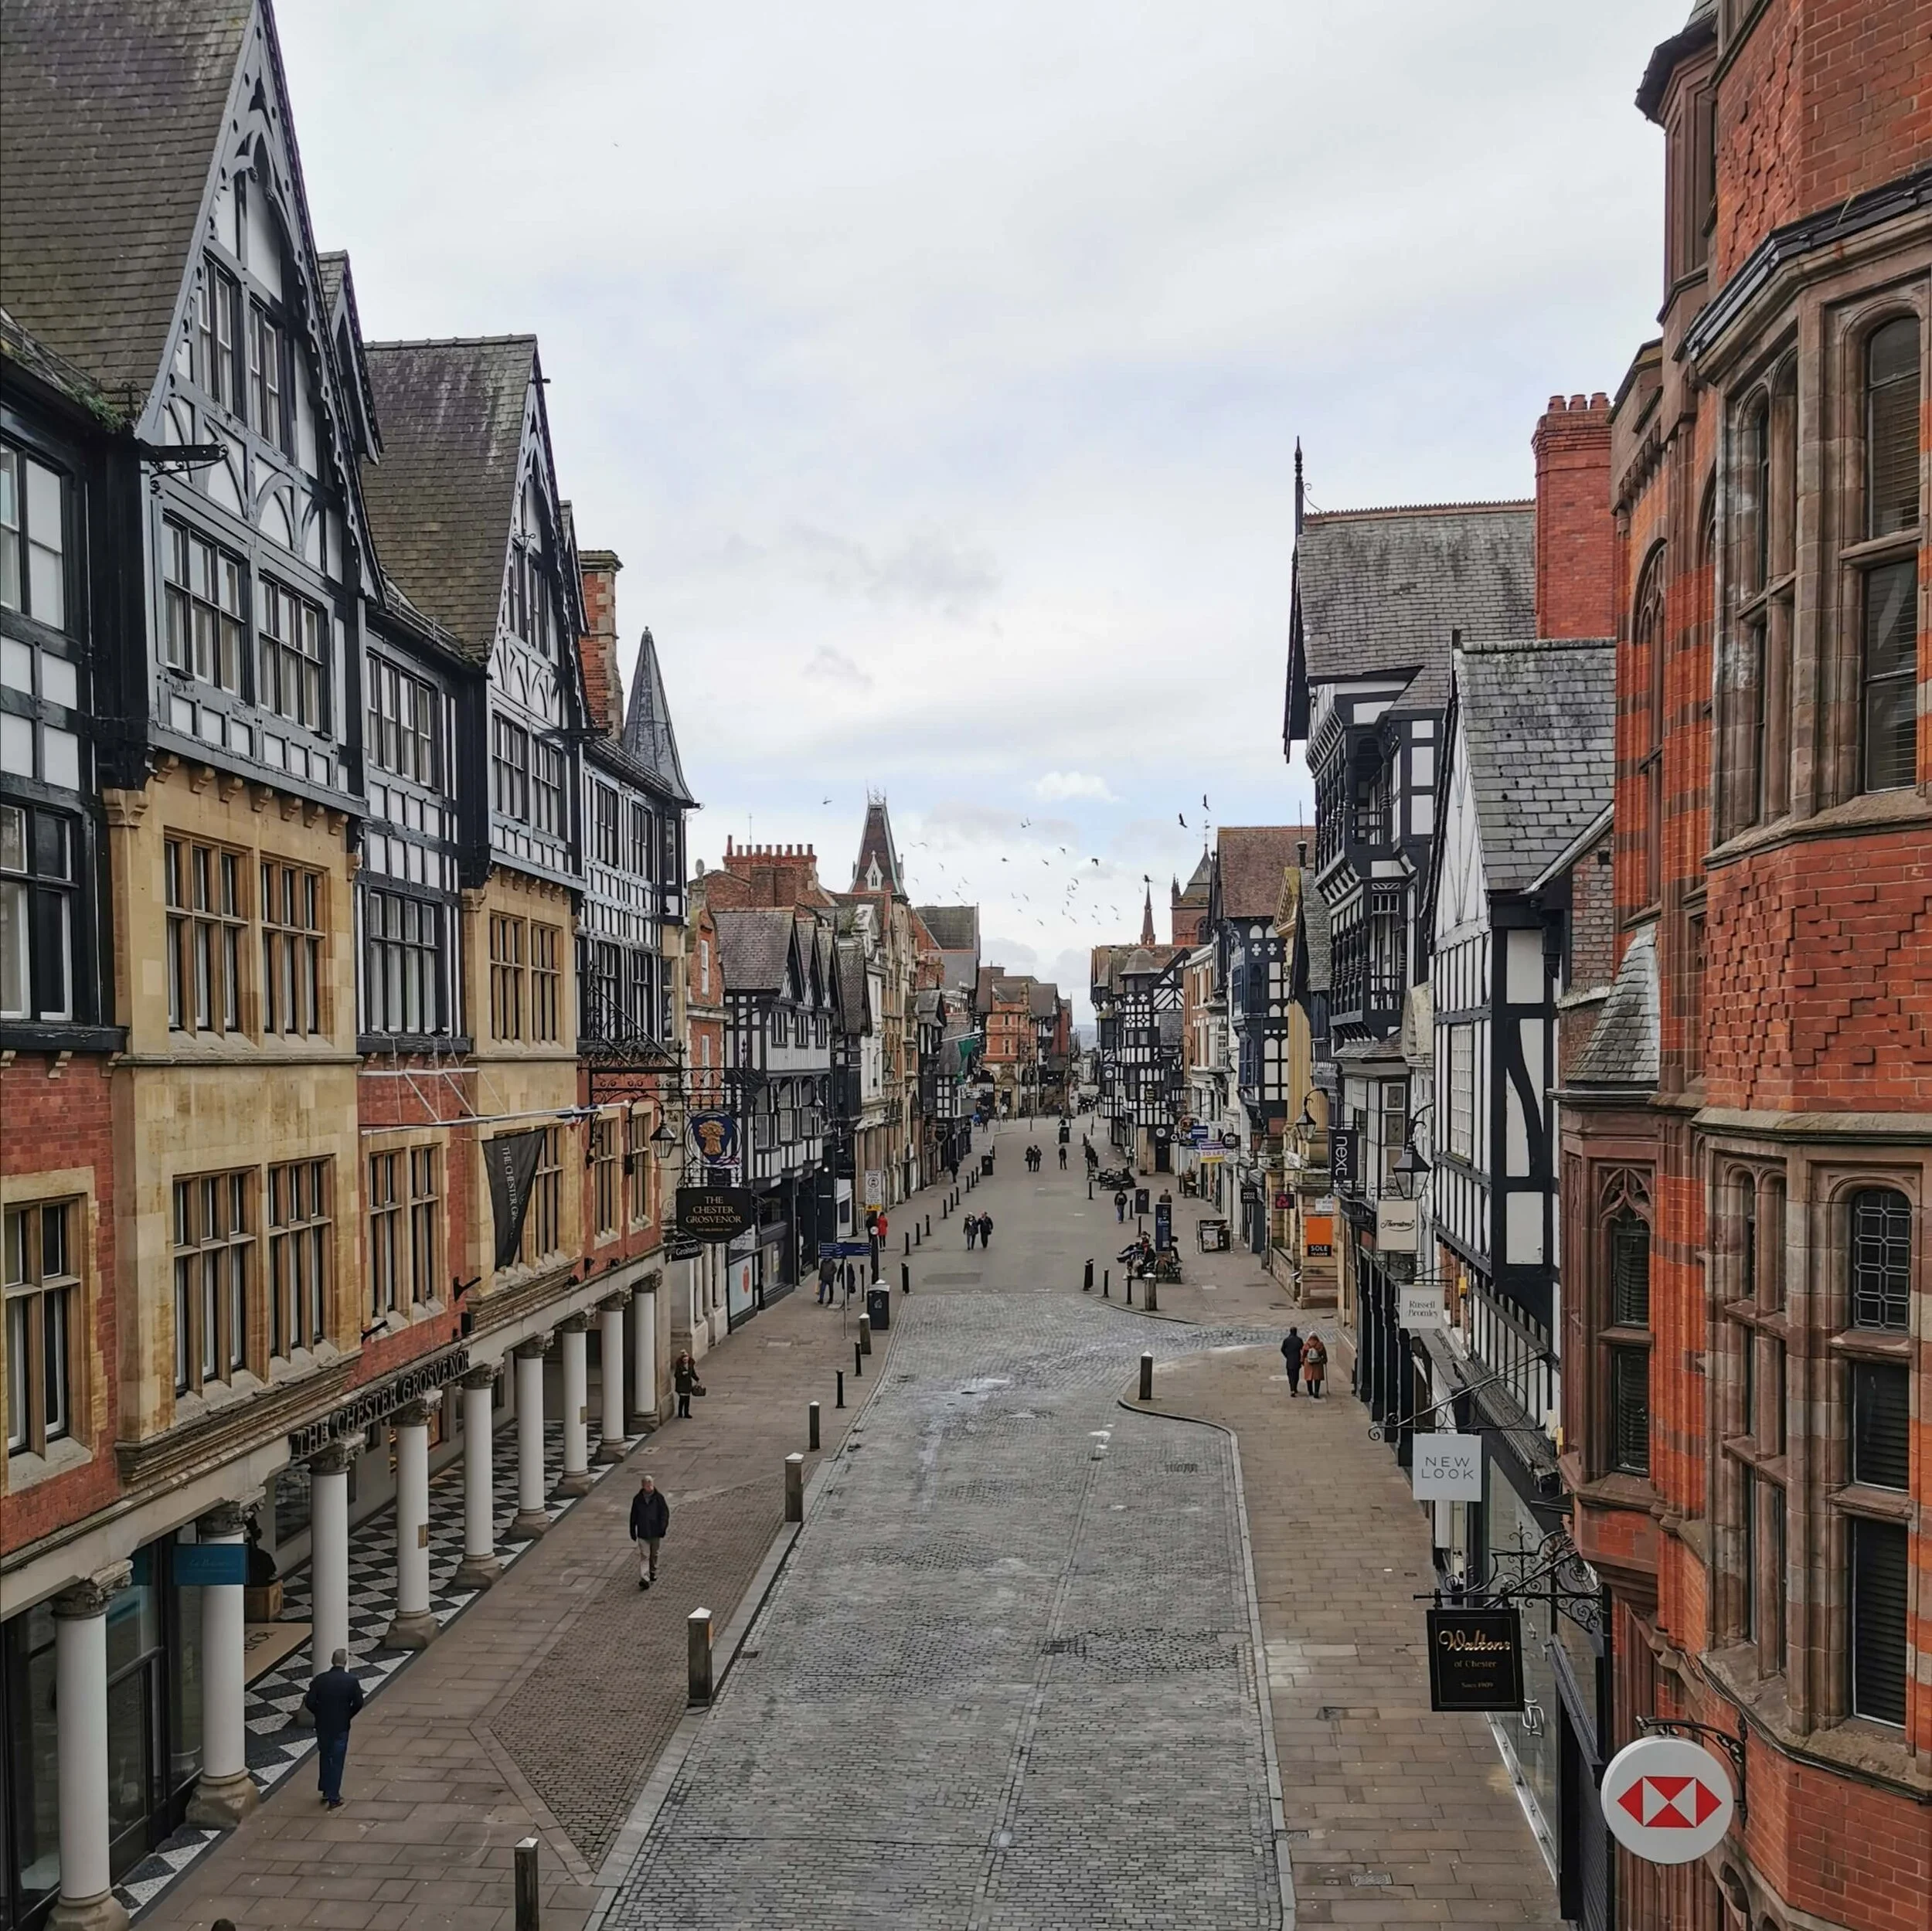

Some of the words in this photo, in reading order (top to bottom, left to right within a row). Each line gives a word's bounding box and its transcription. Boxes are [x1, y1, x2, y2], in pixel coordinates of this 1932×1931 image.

[502, 1145, 512, 1164] THE
[1335, 1136, 1348, 1176] next
[505, 1165, 518, 1205] CHESTER
[704, 1195, 724, 1204] THE
[692, 1205, 735, 1214] CHESTER
[685, 1215, 742, 1224] GROSVENOR
[1407, 1309, 1438, 1318] Bromley
[289, 1419, 329, 1460] THE
[332, 1385, 397, 1438] CHESTER
[400, 1349, 470, 1402] GROSVENOR
[1425, 1457, 1470, 1467] NEW
[1421, 1468, 1474, 1480] LOOK
[1438, 1629, 1511, 1651] Waltons
